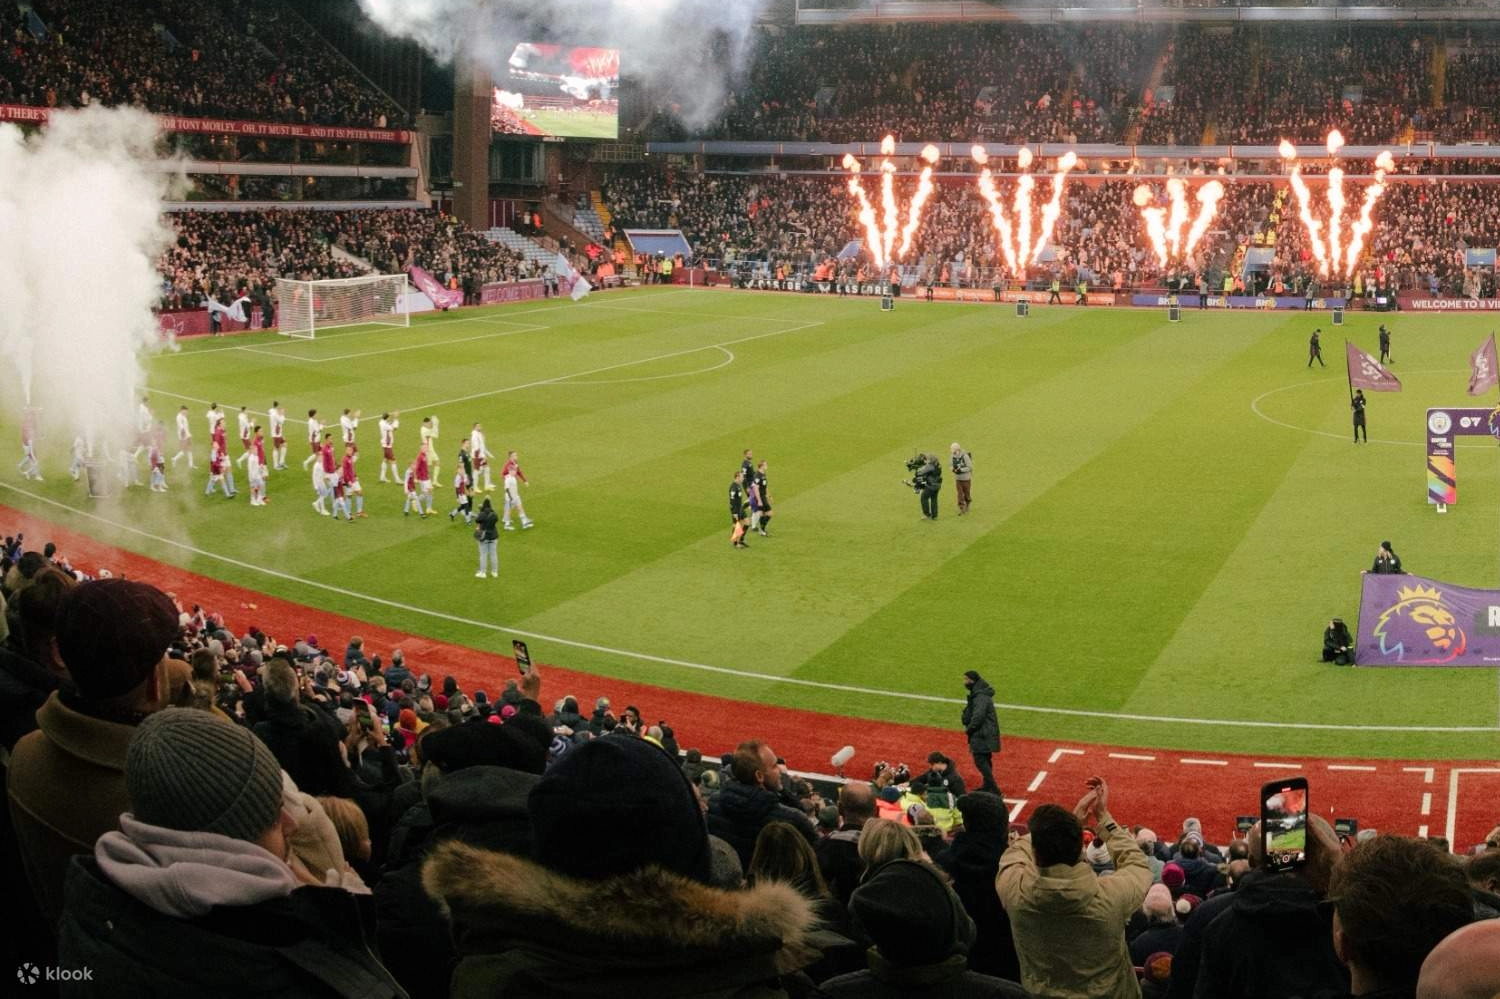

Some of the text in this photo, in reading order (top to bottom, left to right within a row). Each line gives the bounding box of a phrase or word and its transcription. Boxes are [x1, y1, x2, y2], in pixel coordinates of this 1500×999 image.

[177, 119, 200, 130] TONY
[269, 125, 289, 136] MUST
[310, 127, 326, 138] AND
[346, 129, 368, 139] PETER
[1412, 300, 1478, 309] WELCOME TO
